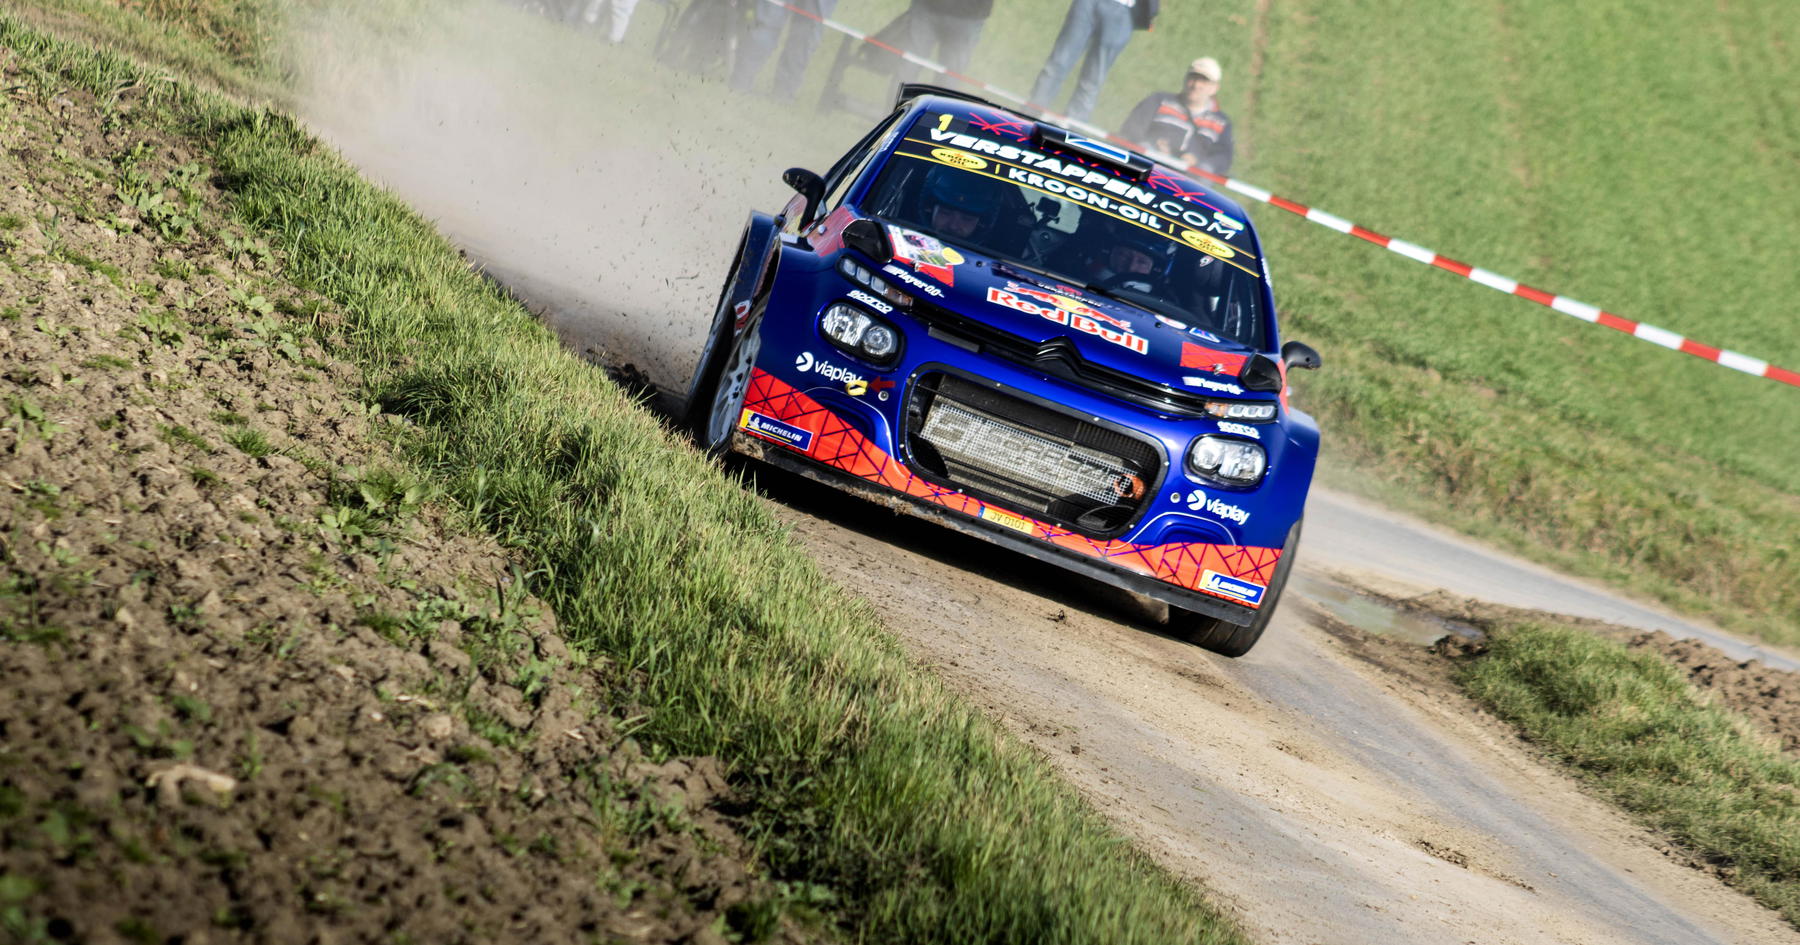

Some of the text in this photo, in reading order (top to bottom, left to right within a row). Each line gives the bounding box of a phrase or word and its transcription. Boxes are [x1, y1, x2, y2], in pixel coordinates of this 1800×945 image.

[938, 114, 953, 131] 1
[930, 127, 1237, 240] VERSTAPPEN.COM
[1007, 166, 1162, 229] KROON-OIL
[847, 290, 893, 314] sparco
[988, 287, 1069, 325] Red
[1071, 314, 1148, 355] Bull
[814, 360, 863, 384] viaplay
[760, 421, 803, 442] MICHELIN
[1207, 498, 1250, 525] viaplay
